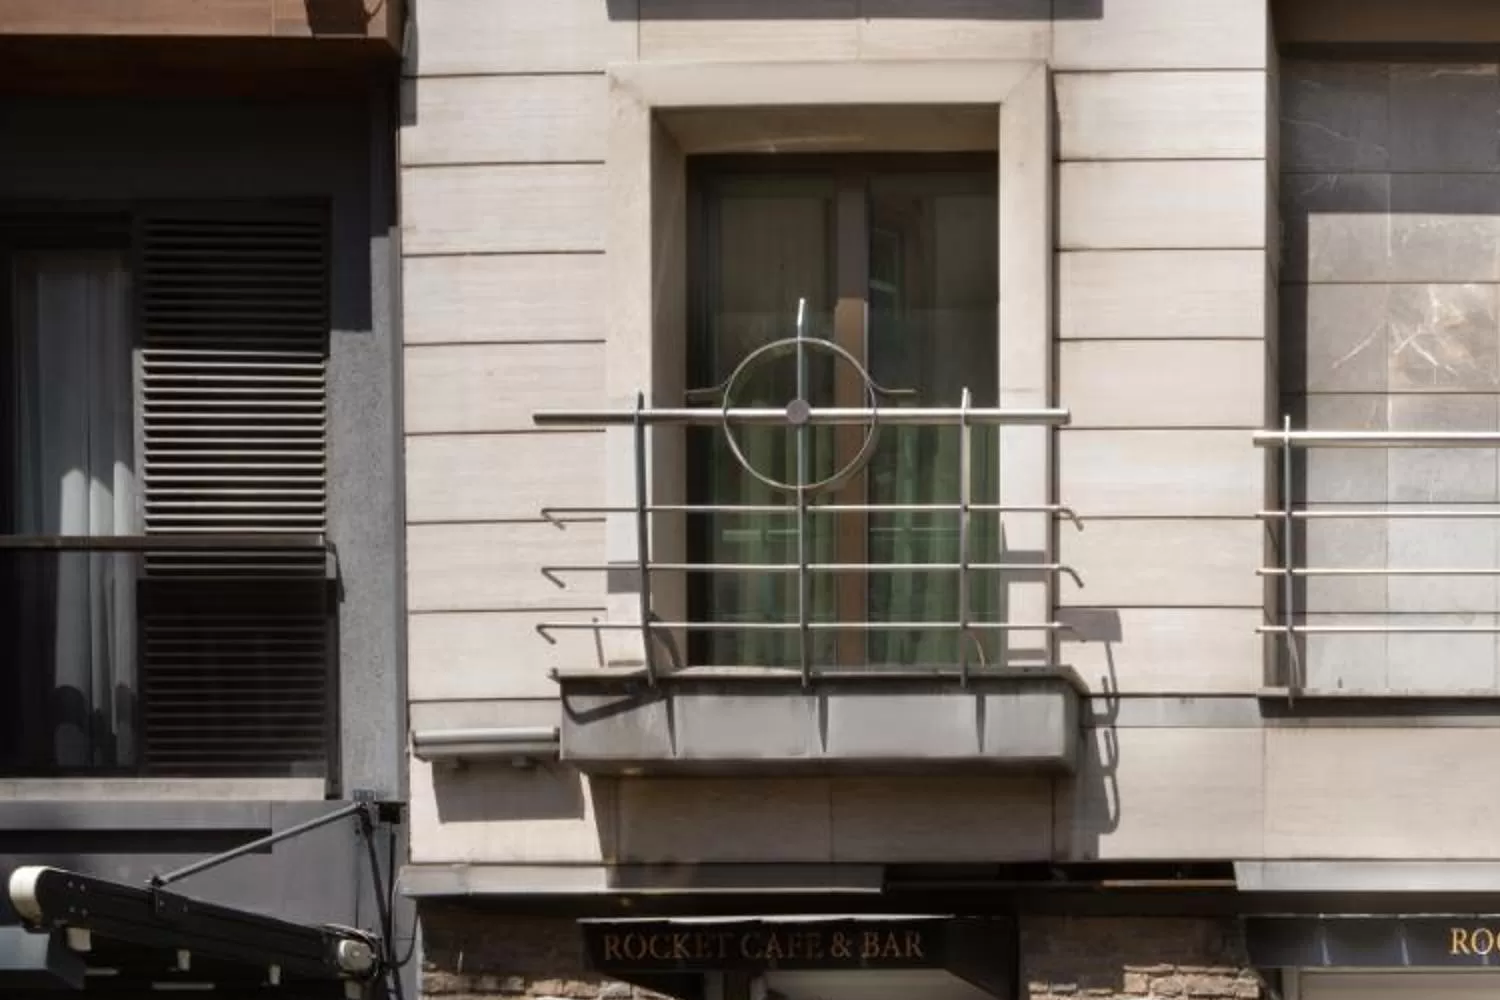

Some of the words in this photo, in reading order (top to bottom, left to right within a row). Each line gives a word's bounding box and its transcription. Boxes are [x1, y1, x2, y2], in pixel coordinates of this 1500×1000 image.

[603, 930, 735, 960] ROCKET
[739, 930, 824, 960] CAFE
[829, 930, 852, 959] &
[861, 930, 924, 959] BAR
